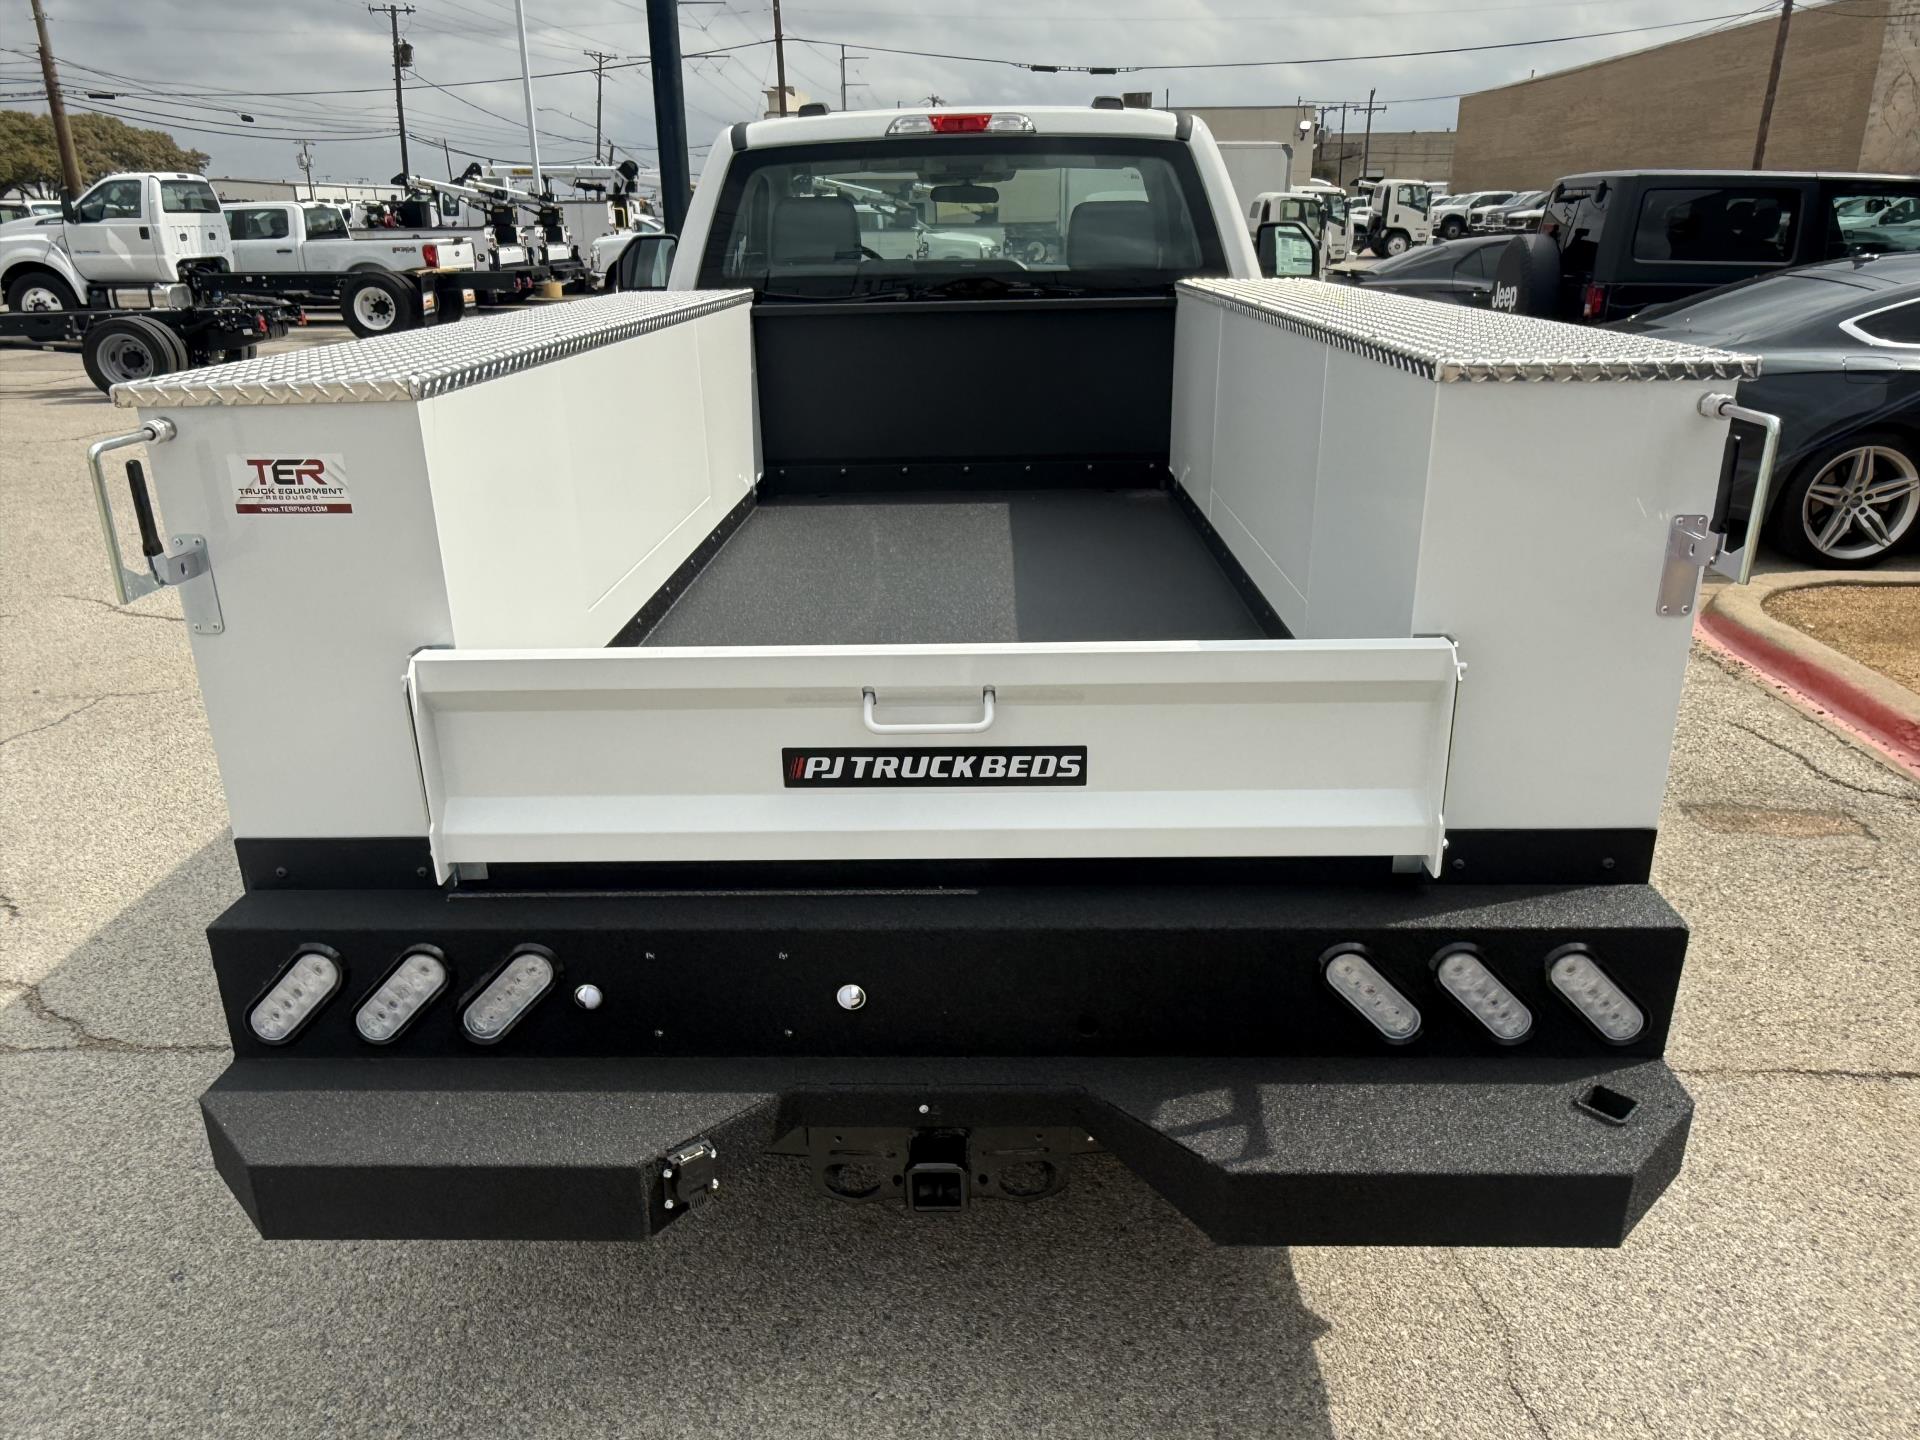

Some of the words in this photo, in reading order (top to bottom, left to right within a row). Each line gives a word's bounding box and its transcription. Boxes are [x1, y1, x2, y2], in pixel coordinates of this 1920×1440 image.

[1491, 280, 1517, 312] Jeep
[246, 459, 328, 486] TER
[803, 756, 845, 779] PJ
